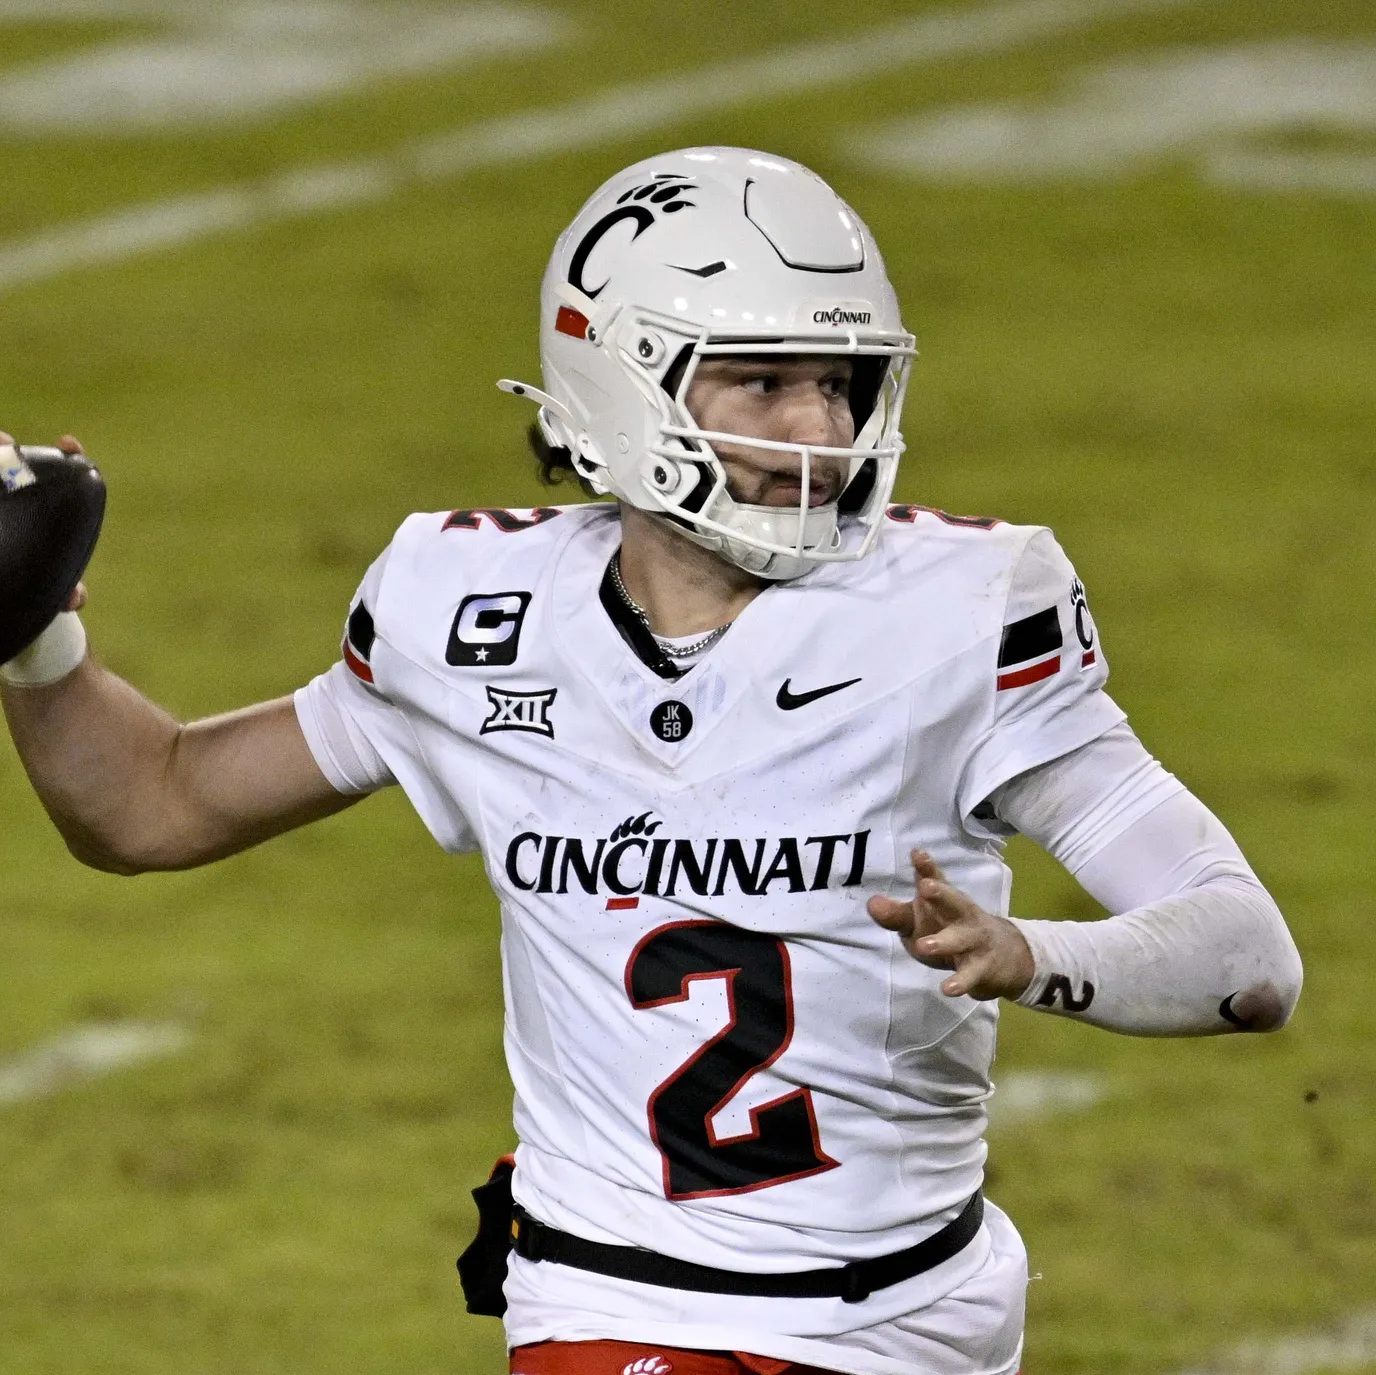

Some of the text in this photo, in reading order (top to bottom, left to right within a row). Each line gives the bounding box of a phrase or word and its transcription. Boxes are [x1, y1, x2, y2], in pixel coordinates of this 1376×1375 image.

[813, 310, 872, 325] CINCINNATI
[457, 595, 522, 644] C
[482, 688, 555, 735] XII
[662, 704, 680, 721] JK
[663, 721, 682, 738] 58
[505, 828, 872, 897] CINCINNATI
[1037, 972, 1095, 1013] 2
[624, 918, 843, 1202] 2
